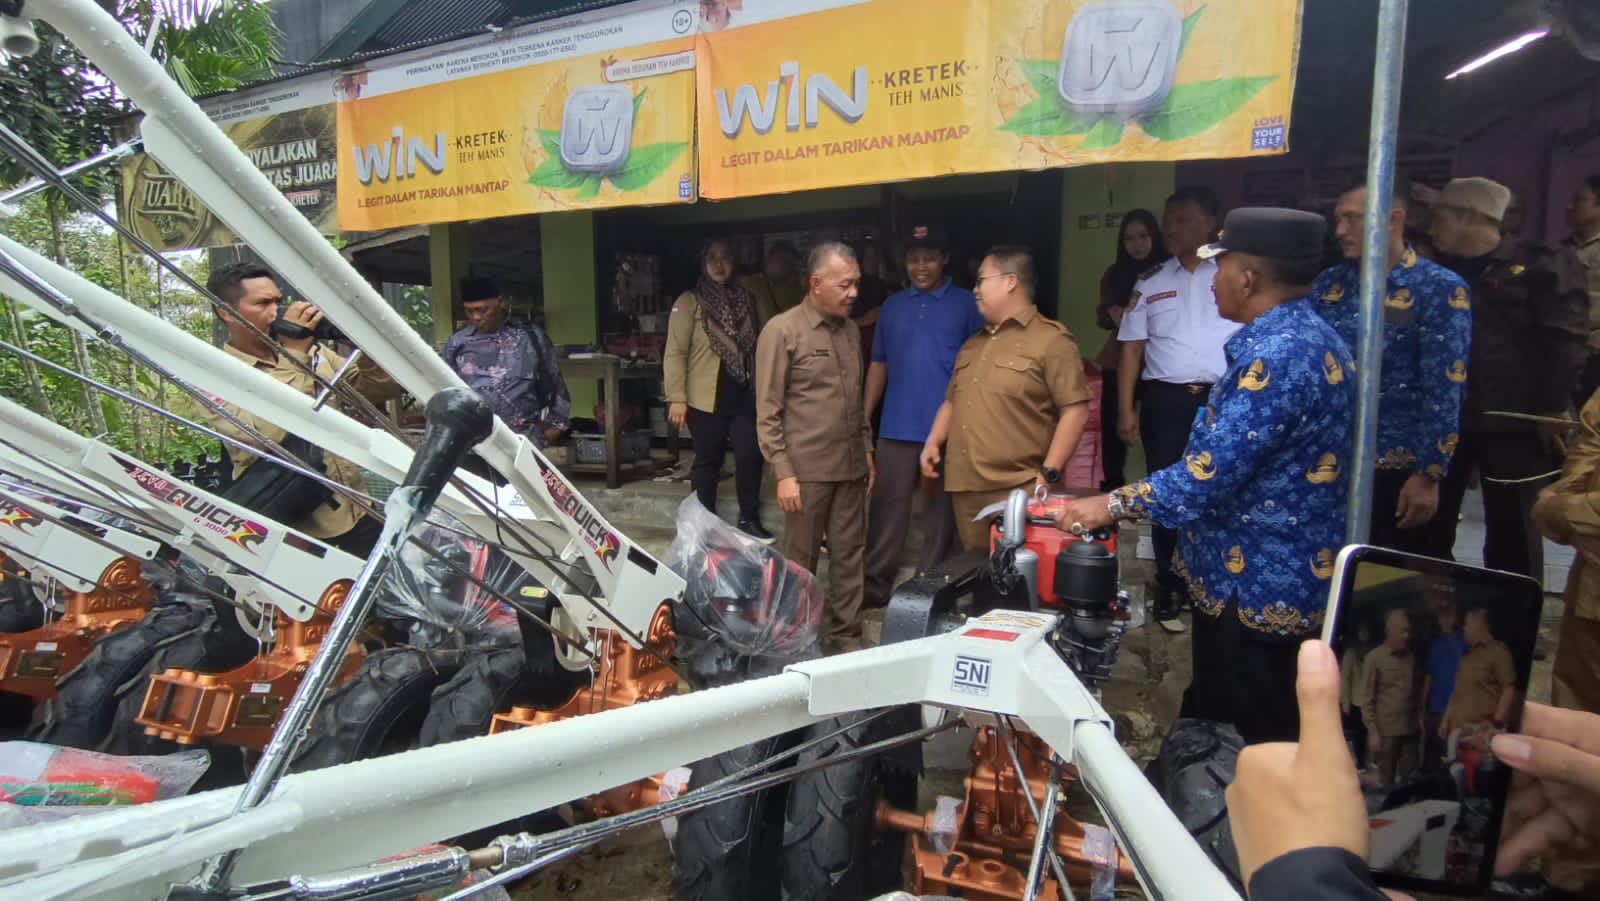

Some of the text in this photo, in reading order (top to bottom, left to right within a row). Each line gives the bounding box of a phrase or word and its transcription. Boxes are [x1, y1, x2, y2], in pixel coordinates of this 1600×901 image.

[884, 59, 967, 88] KRETEK
[887, 82, 964, 108] TEH MANIS
[456, 130, 506, 150] KRETEK
[1254, 127, 1283, 137] YOUR
[1254, 136, 1281, 146] SELF
[459, 146, 505, 164] TEH MANIS
[721, 124, 971, 168] LEGIT DALAM TARIKAN MANTAP
[357, 179, 510, 209] LEGIT DALAM TARIKAN MANTAP
[165, 488, 247, 532] QUICK
[564, 493, 608, 546] QUICK
[954, 660, 990, 684] SNI
